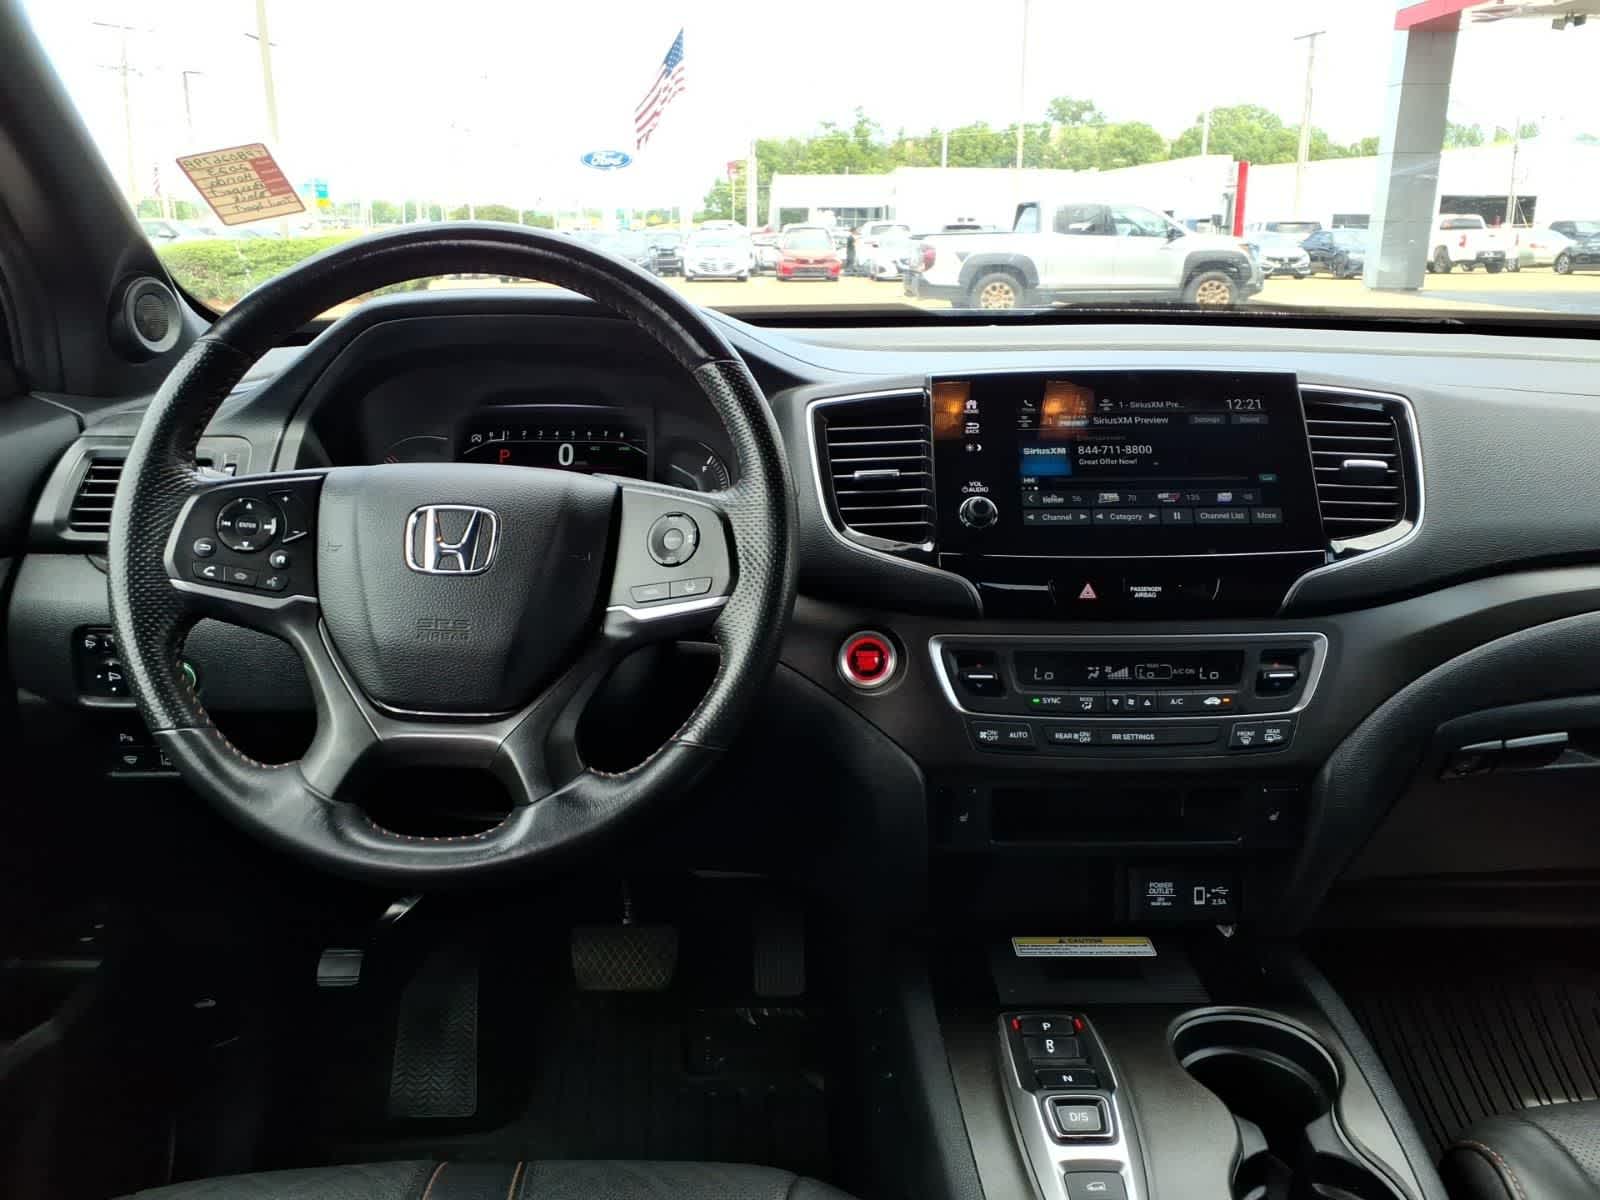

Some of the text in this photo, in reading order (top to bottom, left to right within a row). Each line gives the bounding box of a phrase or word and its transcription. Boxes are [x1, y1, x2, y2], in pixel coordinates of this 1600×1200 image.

[591, 152, 624, 166] Ford
[1225, 398, 1262, 410] 12:21
[1093, 416, 1133, 425] SiriusXM
[1134, 416, 1169, 425] Preview
[558, 442, 575, 466] 0
[1023, 447, 1067, 455] SiriusXM
[1077, 445, 1153, 456] 844-711-8800
[498, 447, 512, 464] P
[1079, 458, 1098, 466] Great
[1041, 513, 1072, 521] Channel
[1110, 512, 1143, 523] Category
[1199, 511, 1245, 520] Channel List
[1256, 511, 1276, 520] More
[1033, 665, 1054, 680] Lo
[1199, 665, 1219, 680] Lo
[1042, 697, 1062, 705] SYNC
[1009, 731, 1028, 739] AUTO
[1055, 732, 1073, 740] REAR
[1122, 732, 1155, 741] SETTINGS
[1042, 1022, 1051, 1031] P
[1062, 1074, 1073, 1082] N
[1069, 1111, 1089, 1122] D/S
